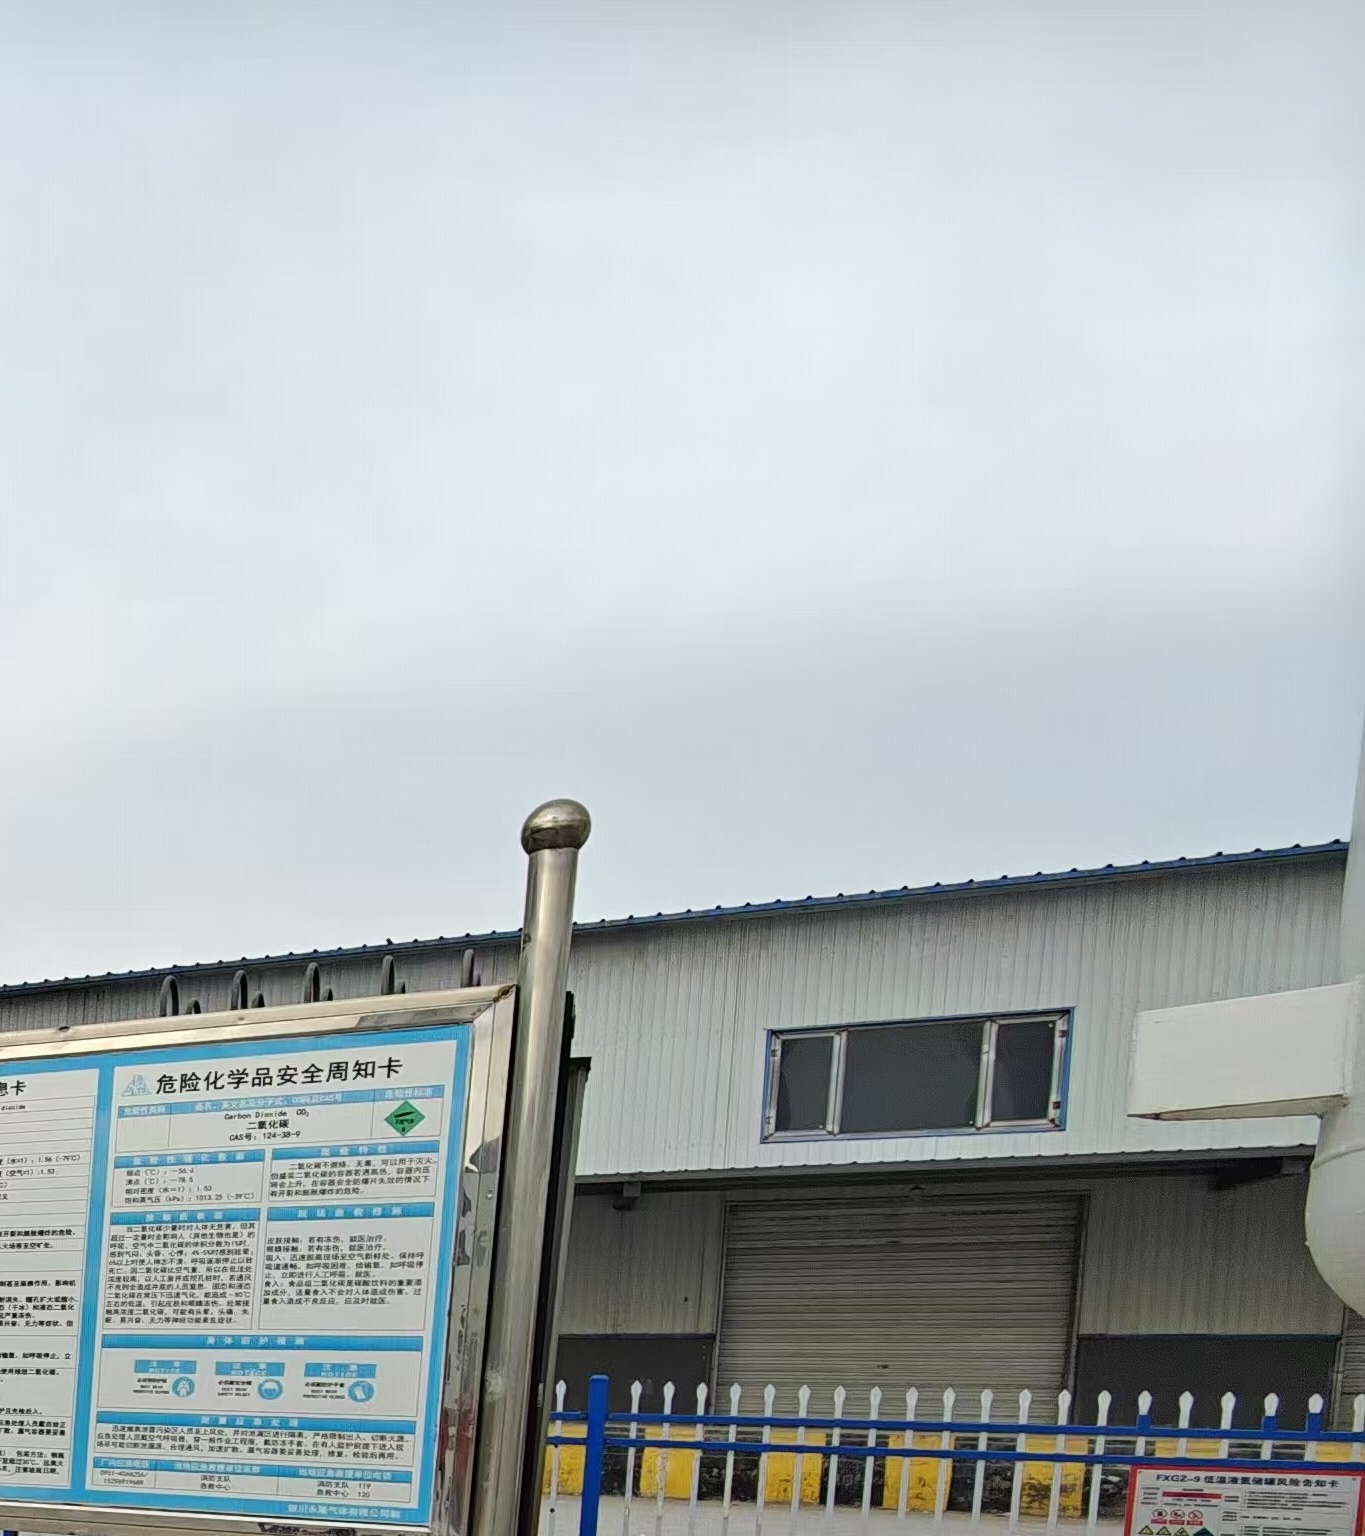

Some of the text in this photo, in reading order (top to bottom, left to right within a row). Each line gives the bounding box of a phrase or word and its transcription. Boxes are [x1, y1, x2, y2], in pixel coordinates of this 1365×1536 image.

[156, 1057, 403, 1095] 危险化学品安全周知卡
[246, 1119, 289, 1130] 二氧化碳
